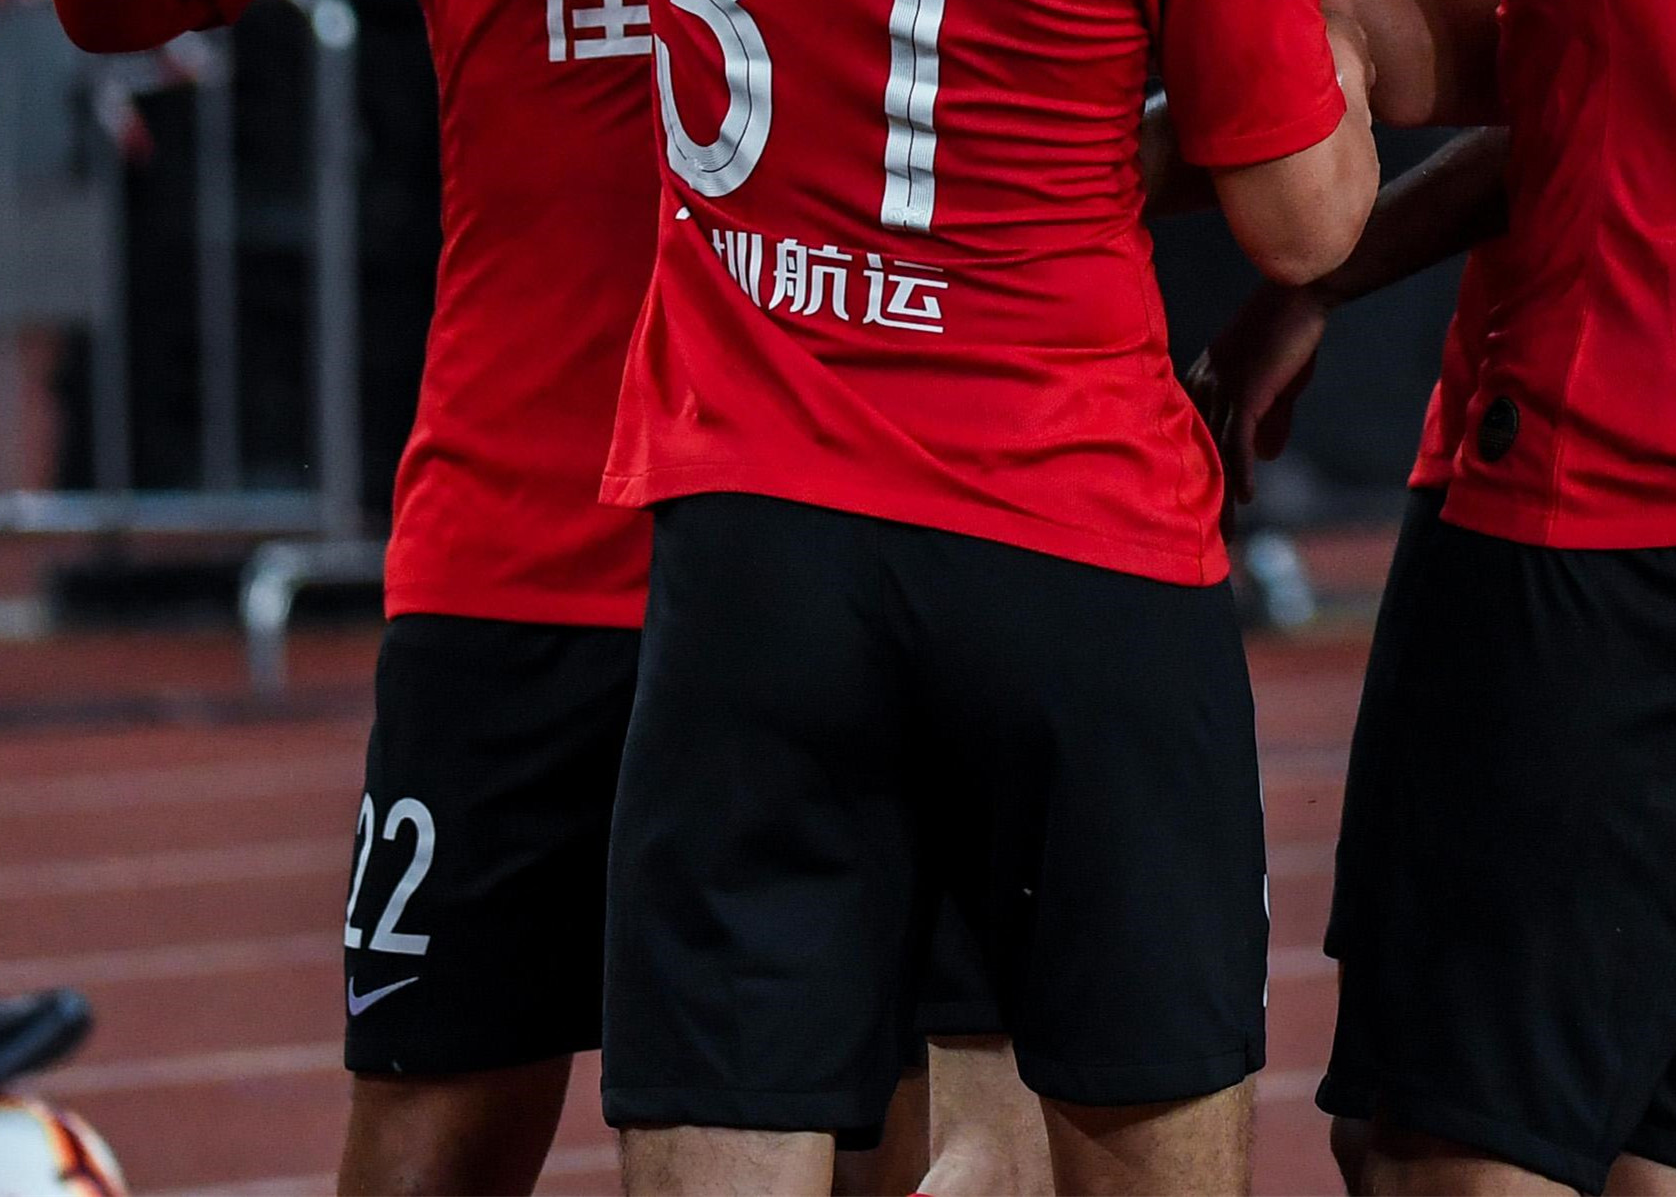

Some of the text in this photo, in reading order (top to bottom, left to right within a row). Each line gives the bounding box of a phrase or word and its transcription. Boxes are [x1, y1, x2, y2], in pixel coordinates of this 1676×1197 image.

[676, 206, 949, 334] 圳航运
[344, 792, 436, 955] 22
